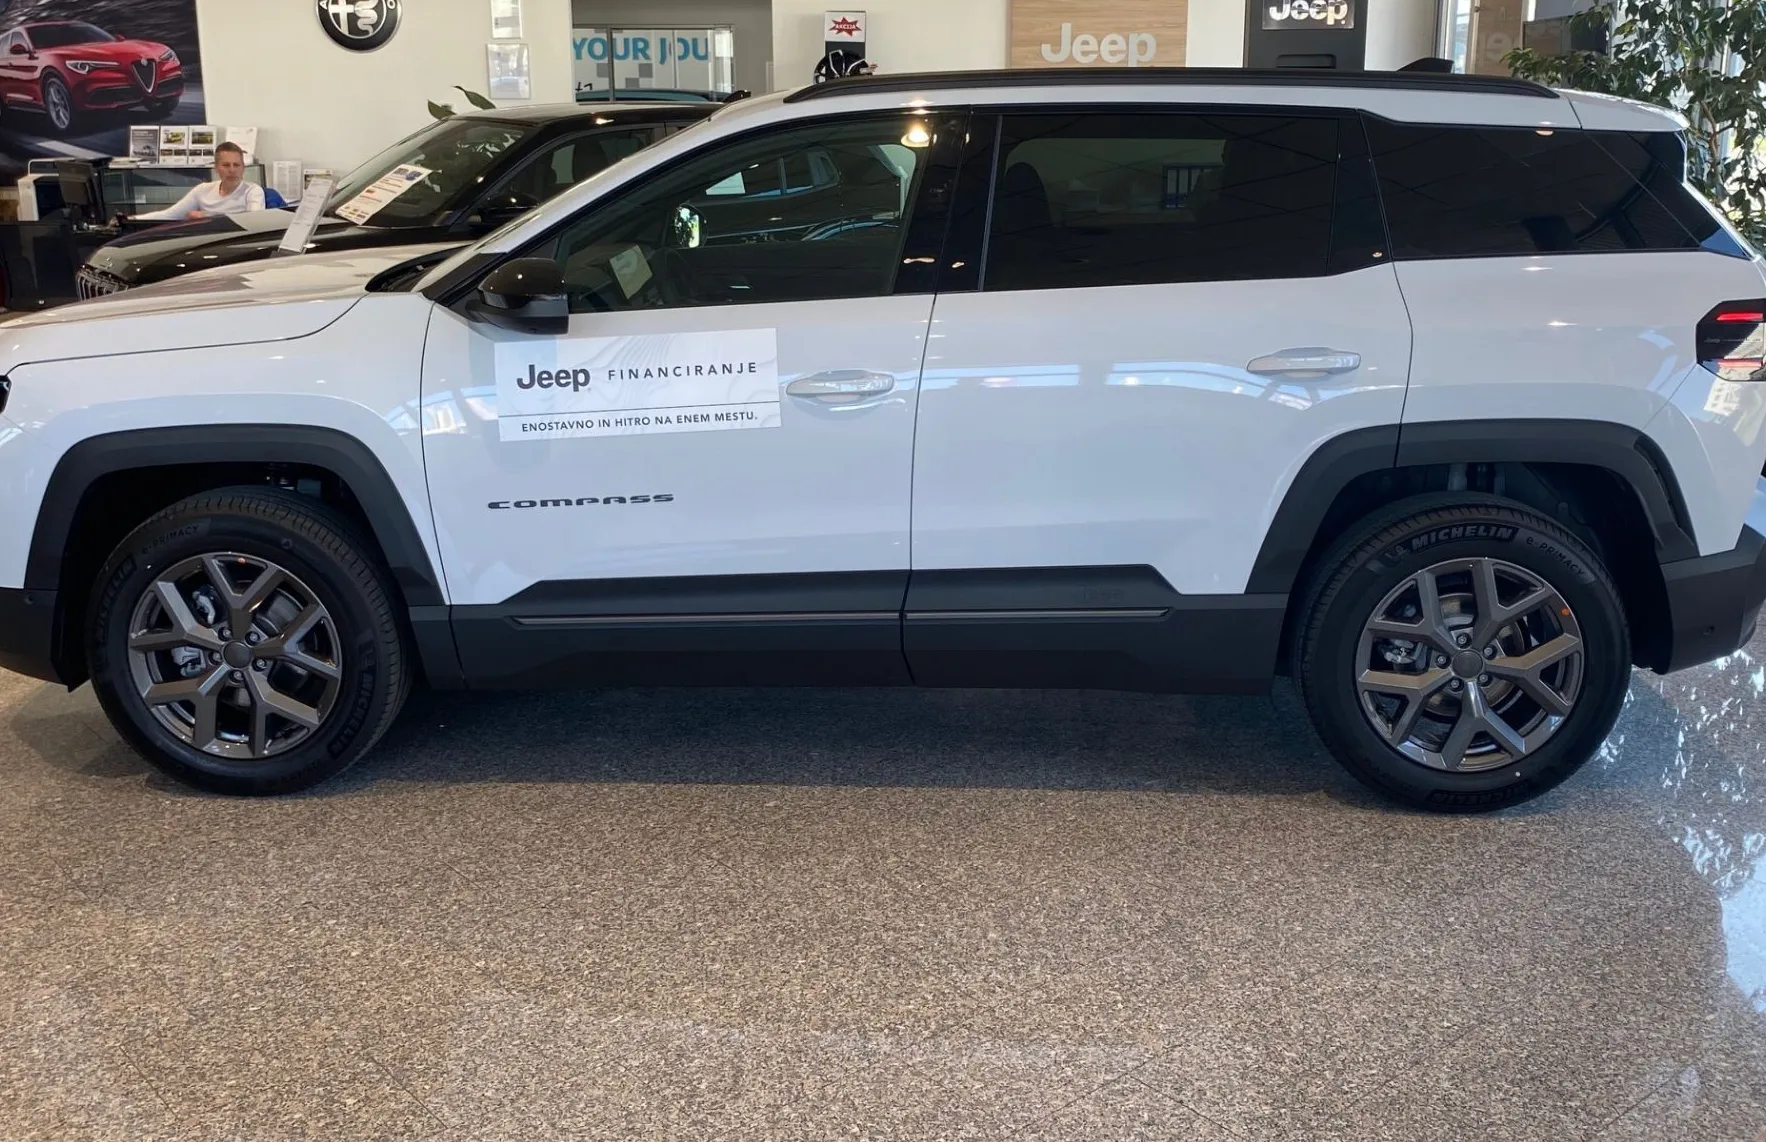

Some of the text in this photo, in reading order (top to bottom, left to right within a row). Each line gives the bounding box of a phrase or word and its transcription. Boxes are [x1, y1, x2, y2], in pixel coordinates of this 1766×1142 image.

[1269, 0, 1348, 25] Jeep
[572, 37, 651, 61] YOUR
[1041, 22, 1157, 67] Jeep
[516, 362, 757, 392] Jeep FINANCIRANJE
[522, 411, 758, 432] ENOSTAVNO IN HITRO NA ENEM MESTU.
[1411, 525, 1514, 551] MICHELIN
